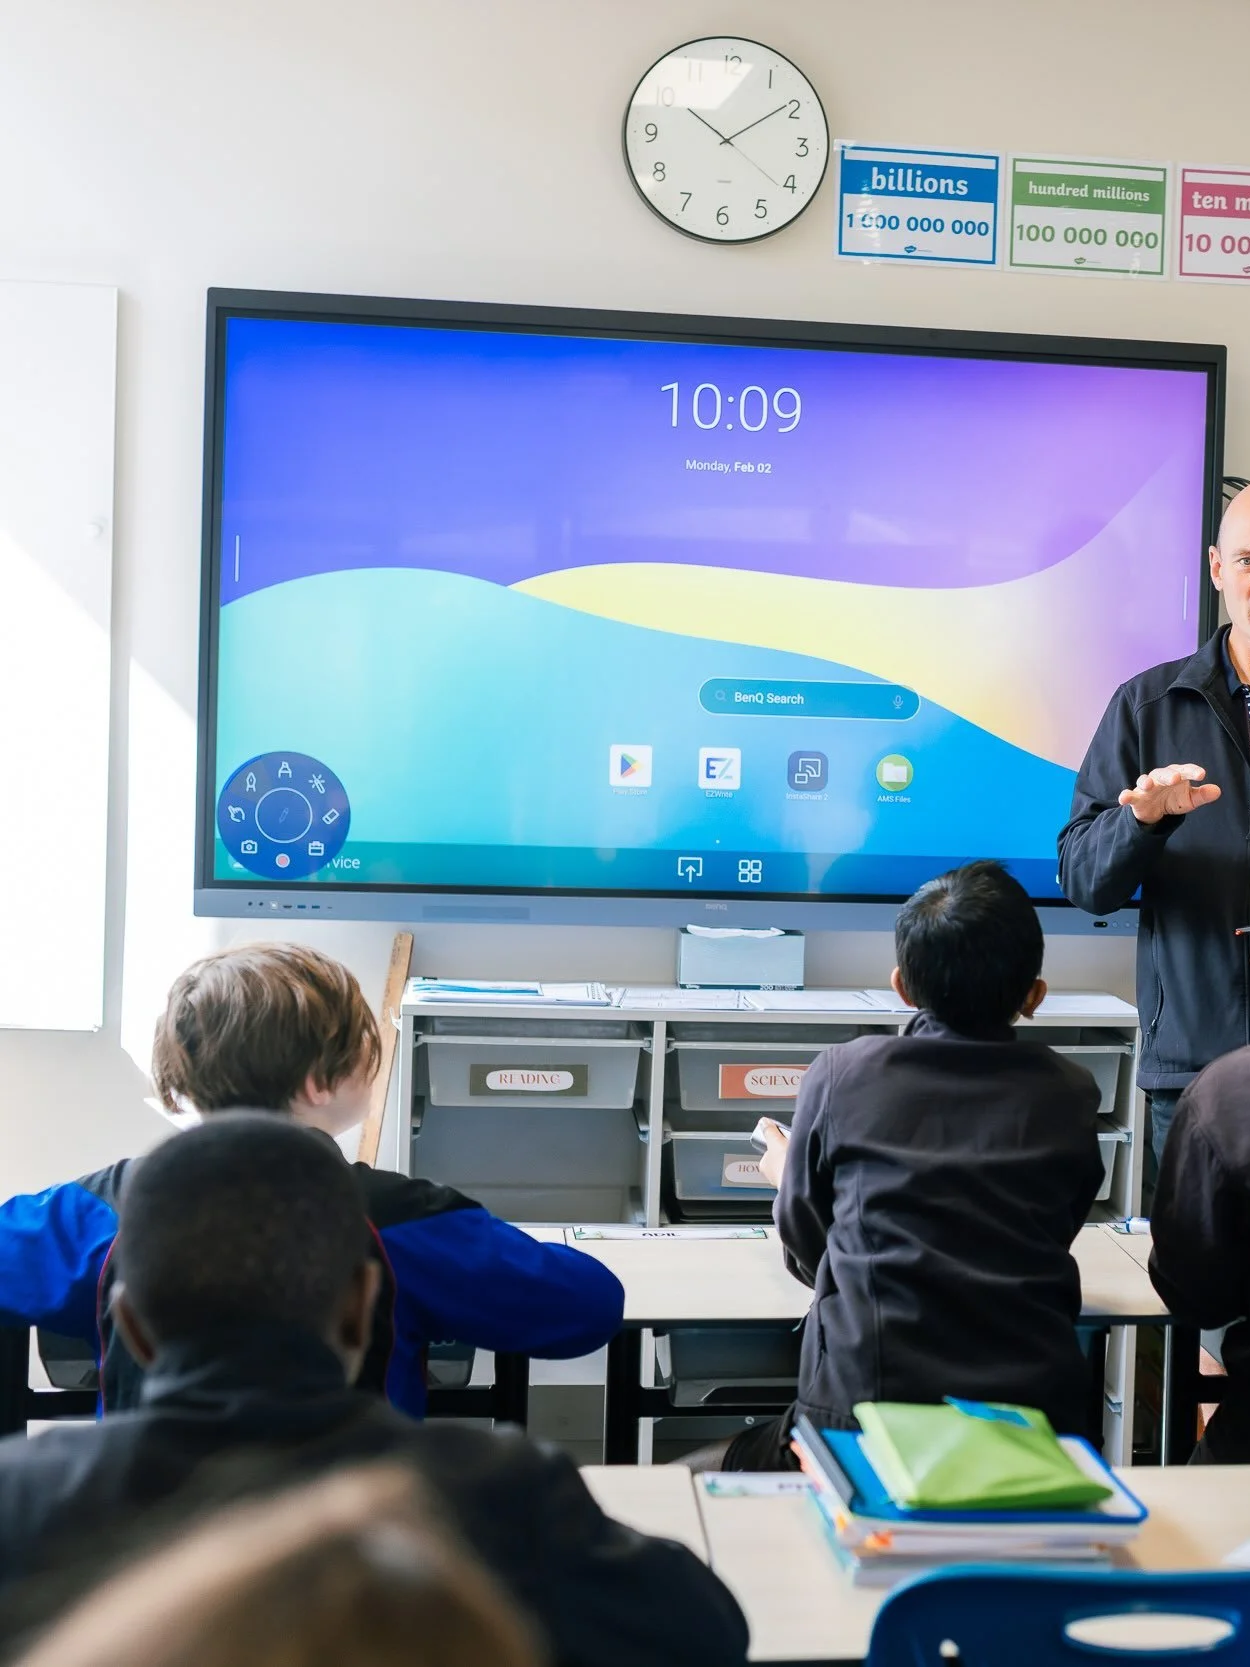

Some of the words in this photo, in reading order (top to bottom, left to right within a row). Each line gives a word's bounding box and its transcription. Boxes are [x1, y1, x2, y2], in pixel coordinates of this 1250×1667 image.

[724, 54, 743, 76] 12
[768, 69, 773, 89] 1
[656, 86, 675, 107] 10
[787, 99, 801, 120] 2
[644, 123, 658, 143] 9
[795, 137, 809, 157] 3
[652, 161, 666, 182] 8
[871, 166, 969, 196] billions
[782, 174, 798, 194] 4
[1028, 181, 1089, 198] hundred
[1093, 186, 1150, 202] millions
[680, 191, 692, 212] 7
[754, 199, 768, 219] 5
[1191, 191, 1228, 210] ten
[716, 205, 730, 226] 6
[846, 213, 855, 228] 1
[906, 216, 945, 233] 000
[951, 219, 990, 237] 000
[1015, 223, 1055, 243] 100
[1063, 227, 1108, 246] 000
[1115, 230, 1159, 249] 000
[1185, 233, 1212, 253] 10
[661, 381, 802, 433] 10:09
[685, 459, 732, 474] Monday,
[734, 461, 755, 473] Feb
[757, 463, 772, 474] 02
[734, 691, 764, 706] BenQ
[766, 692, 804, 706] Search
[877, 795, 894, 803] AMS
[327, 855, 361, 869] vice
[499, 1073, 562, 1086] READING
